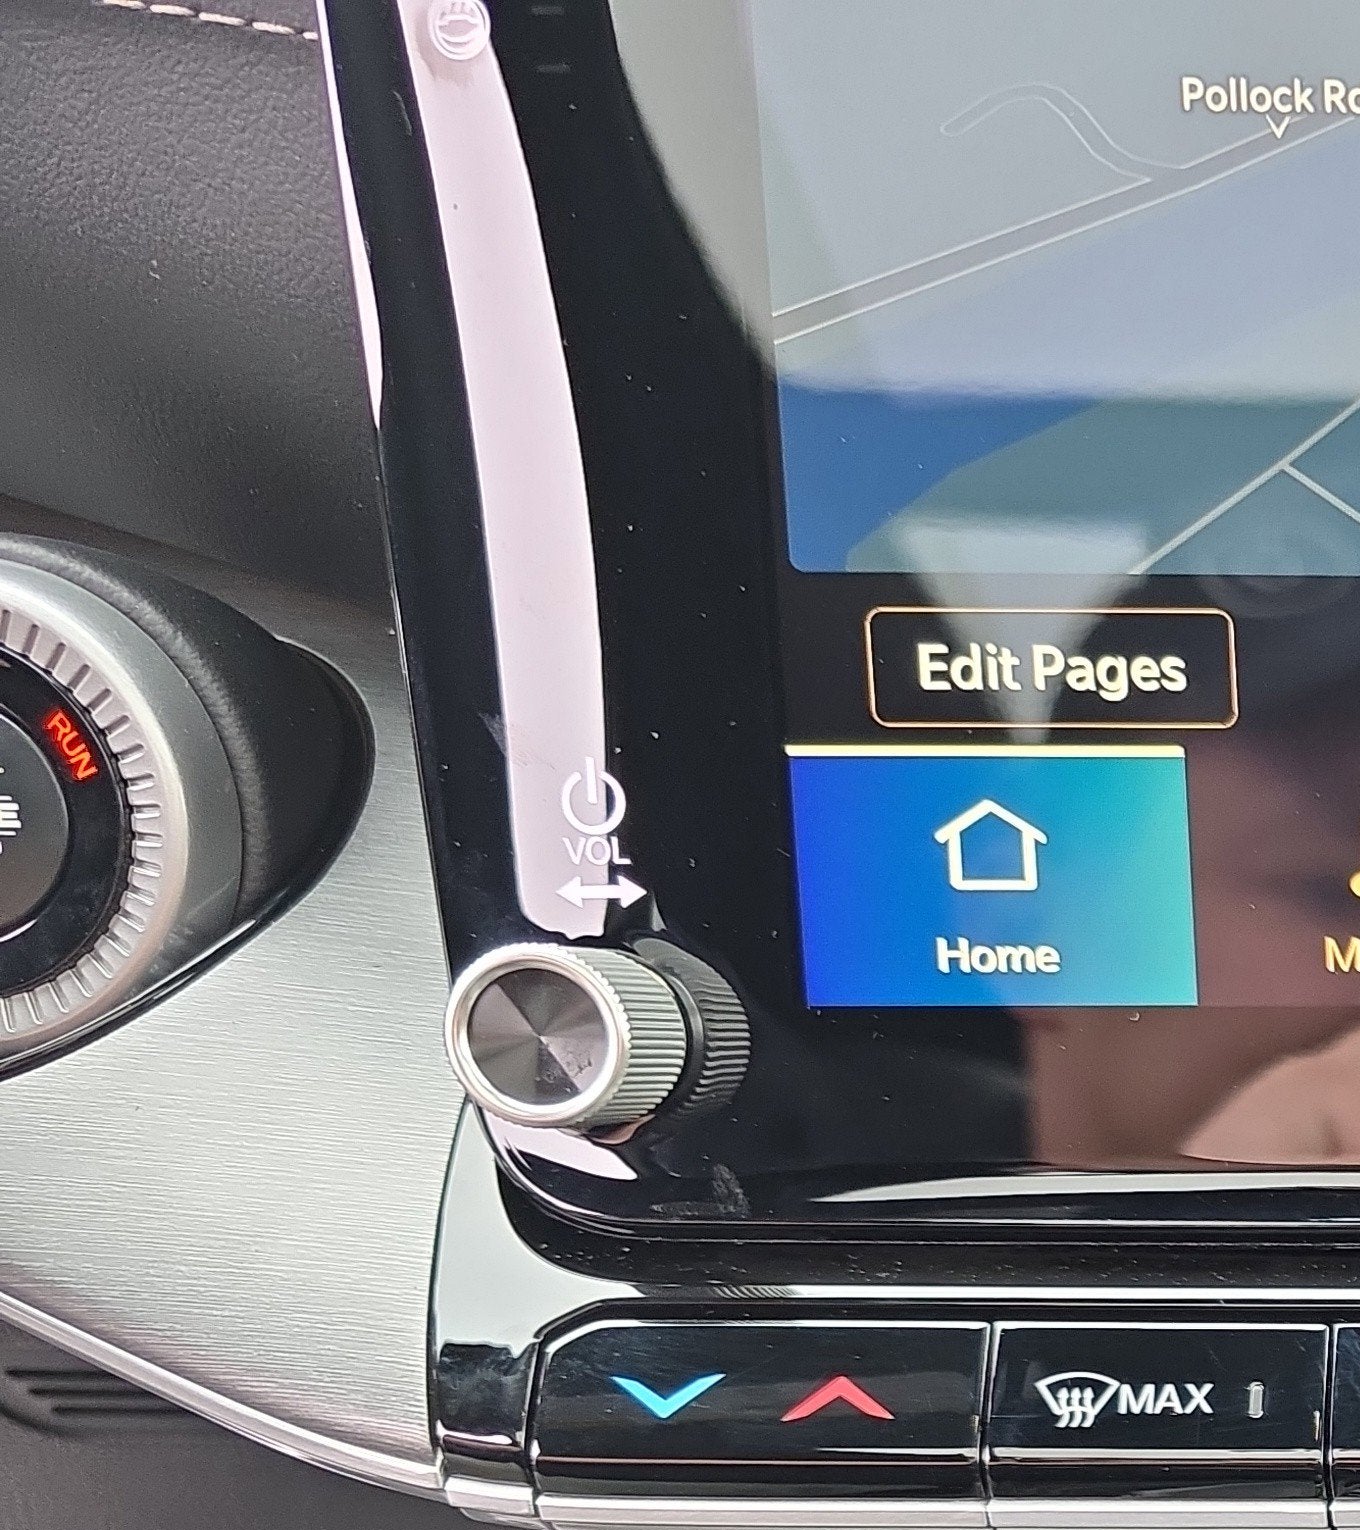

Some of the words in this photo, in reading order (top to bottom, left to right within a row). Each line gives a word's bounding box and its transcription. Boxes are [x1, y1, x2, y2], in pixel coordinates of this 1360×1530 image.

[1181, 76, 1315, 113] Pollock
[917, 642, 1022, 692] Edit
[1032, 643, 1188, 702] Pages
[46, 711, 98, 780] RUN
[561, 835, 633, 866] VOL
[935, 937, 1062, 974] Home
[1116, 1383, 1215, 1416] MAX
